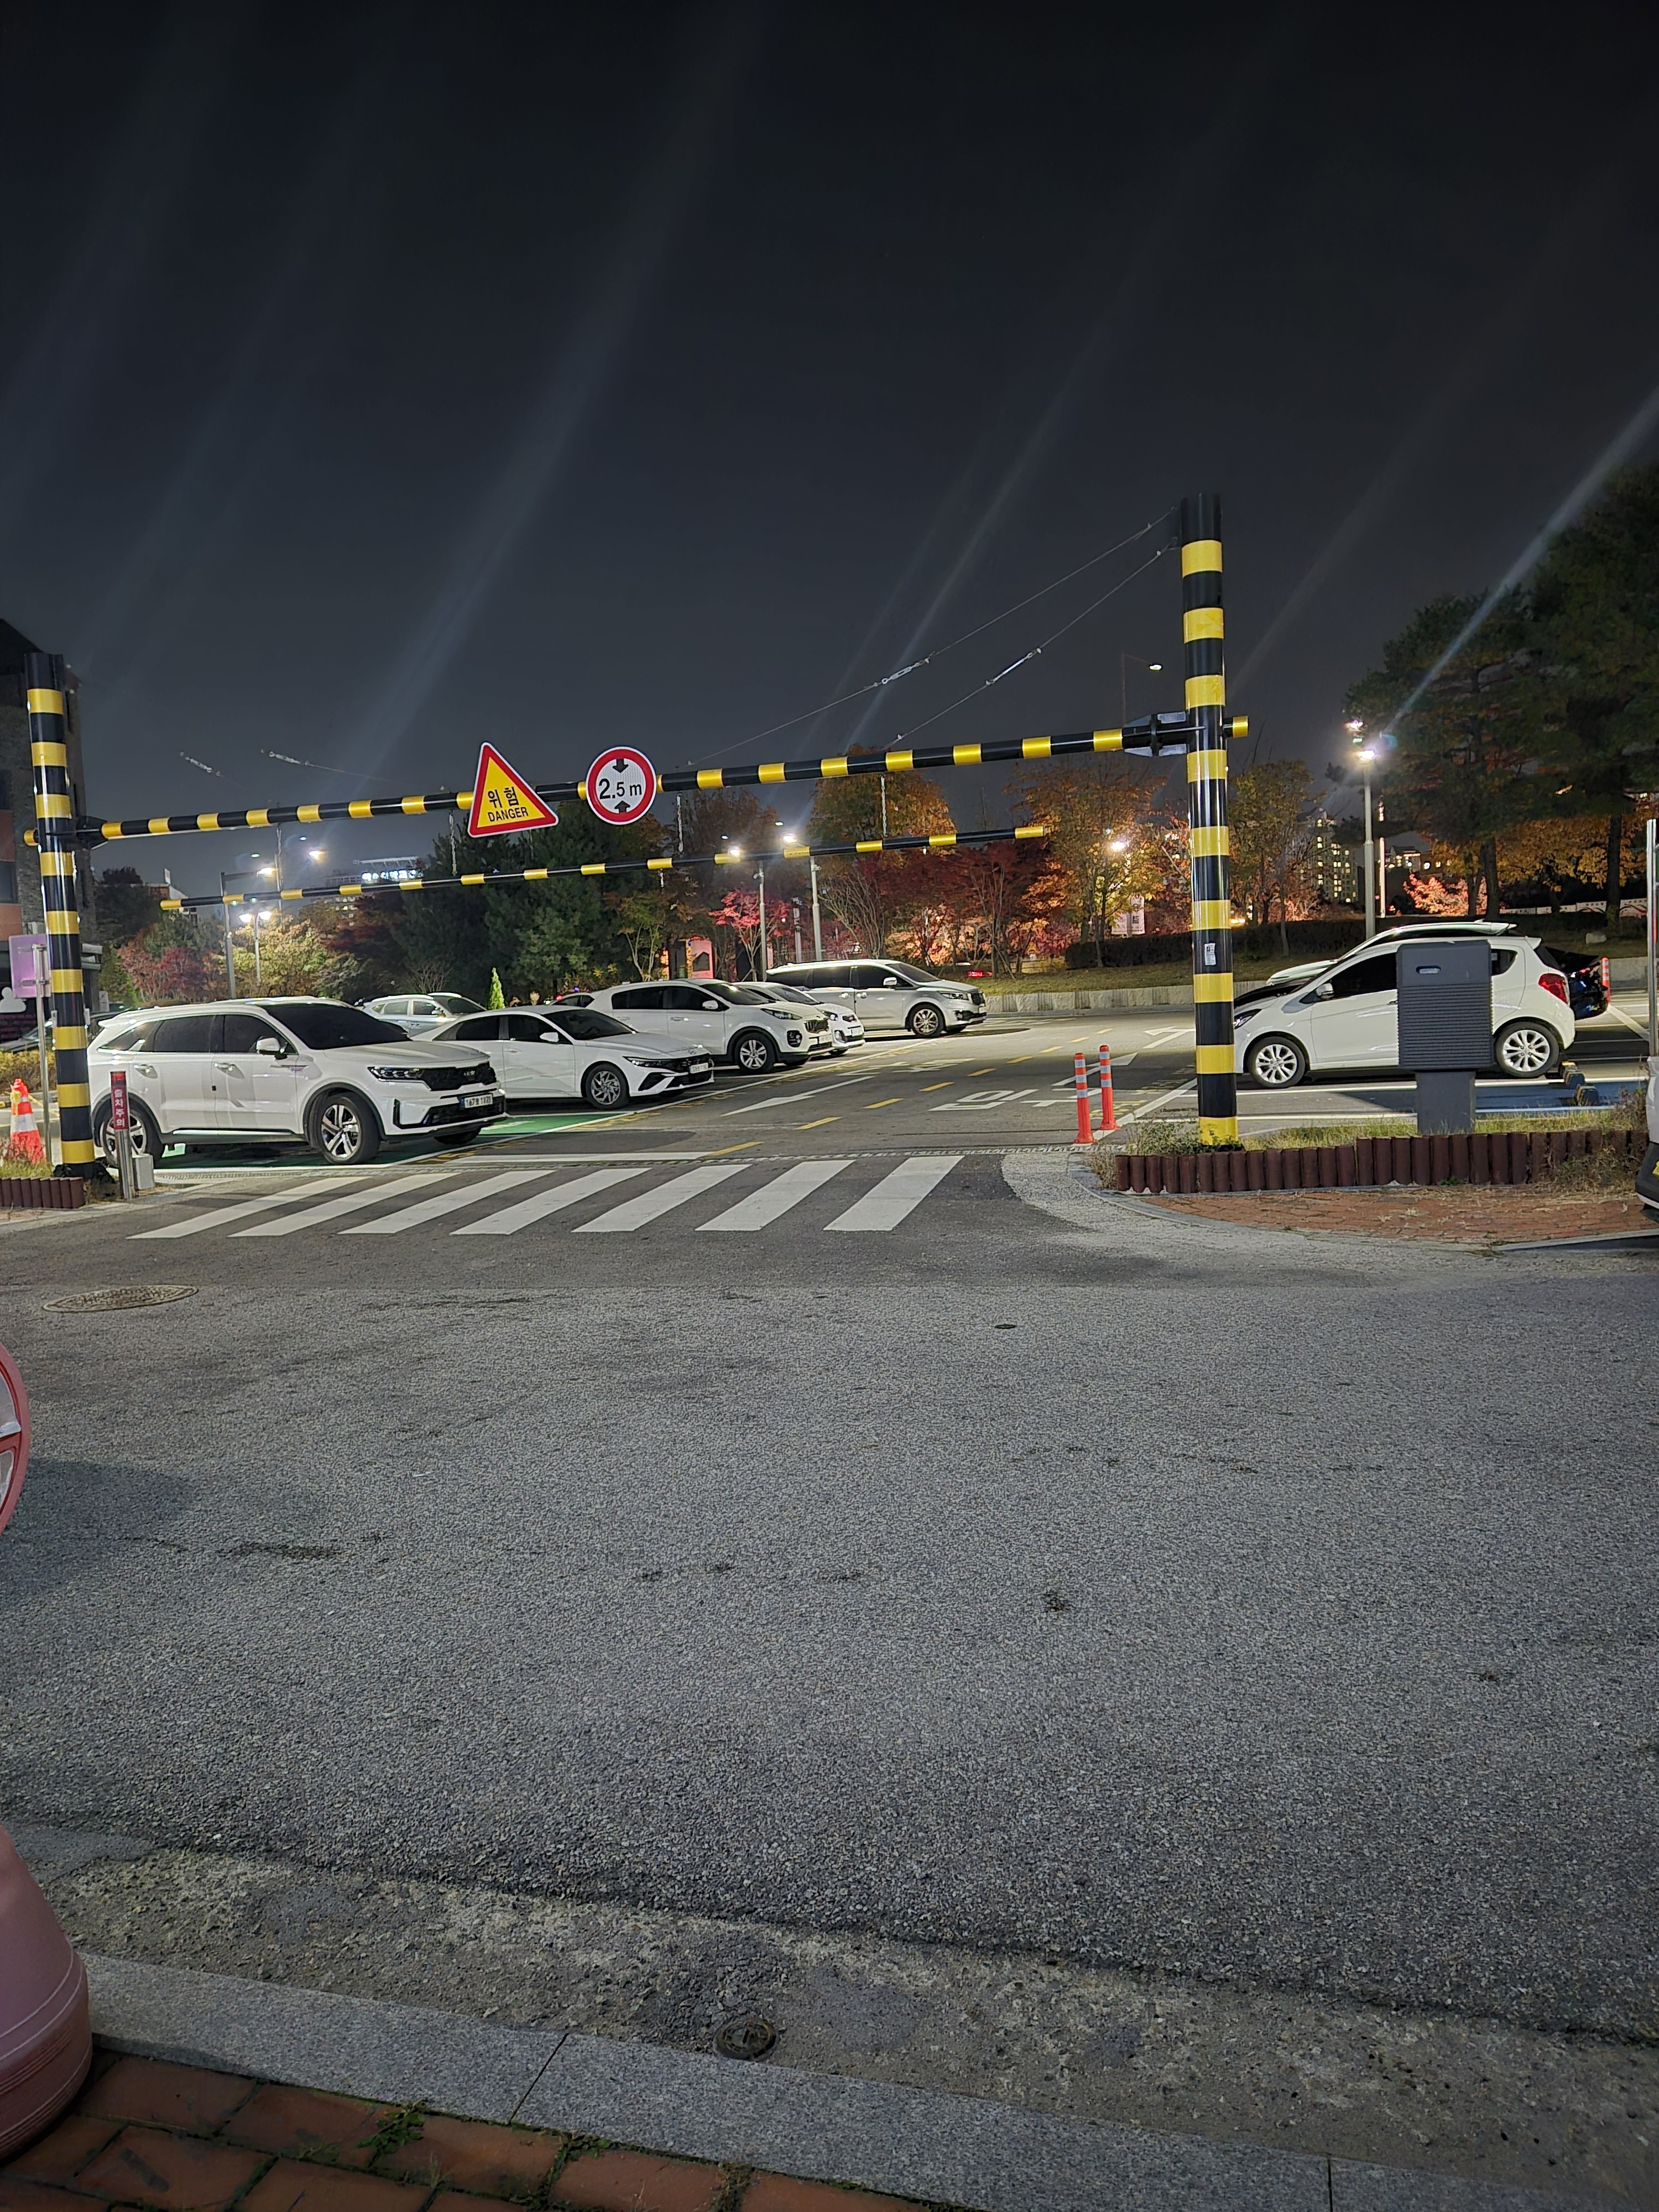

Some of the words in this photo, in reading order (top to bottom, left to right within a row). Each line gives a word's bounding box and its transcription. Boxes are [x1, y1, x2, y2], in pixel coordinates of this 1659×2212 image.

[488, 807, 529, 822] DANGER
[114, 1089, 126, 1127] 출차주의
[928, 1088, 1102, 1112] 입구
